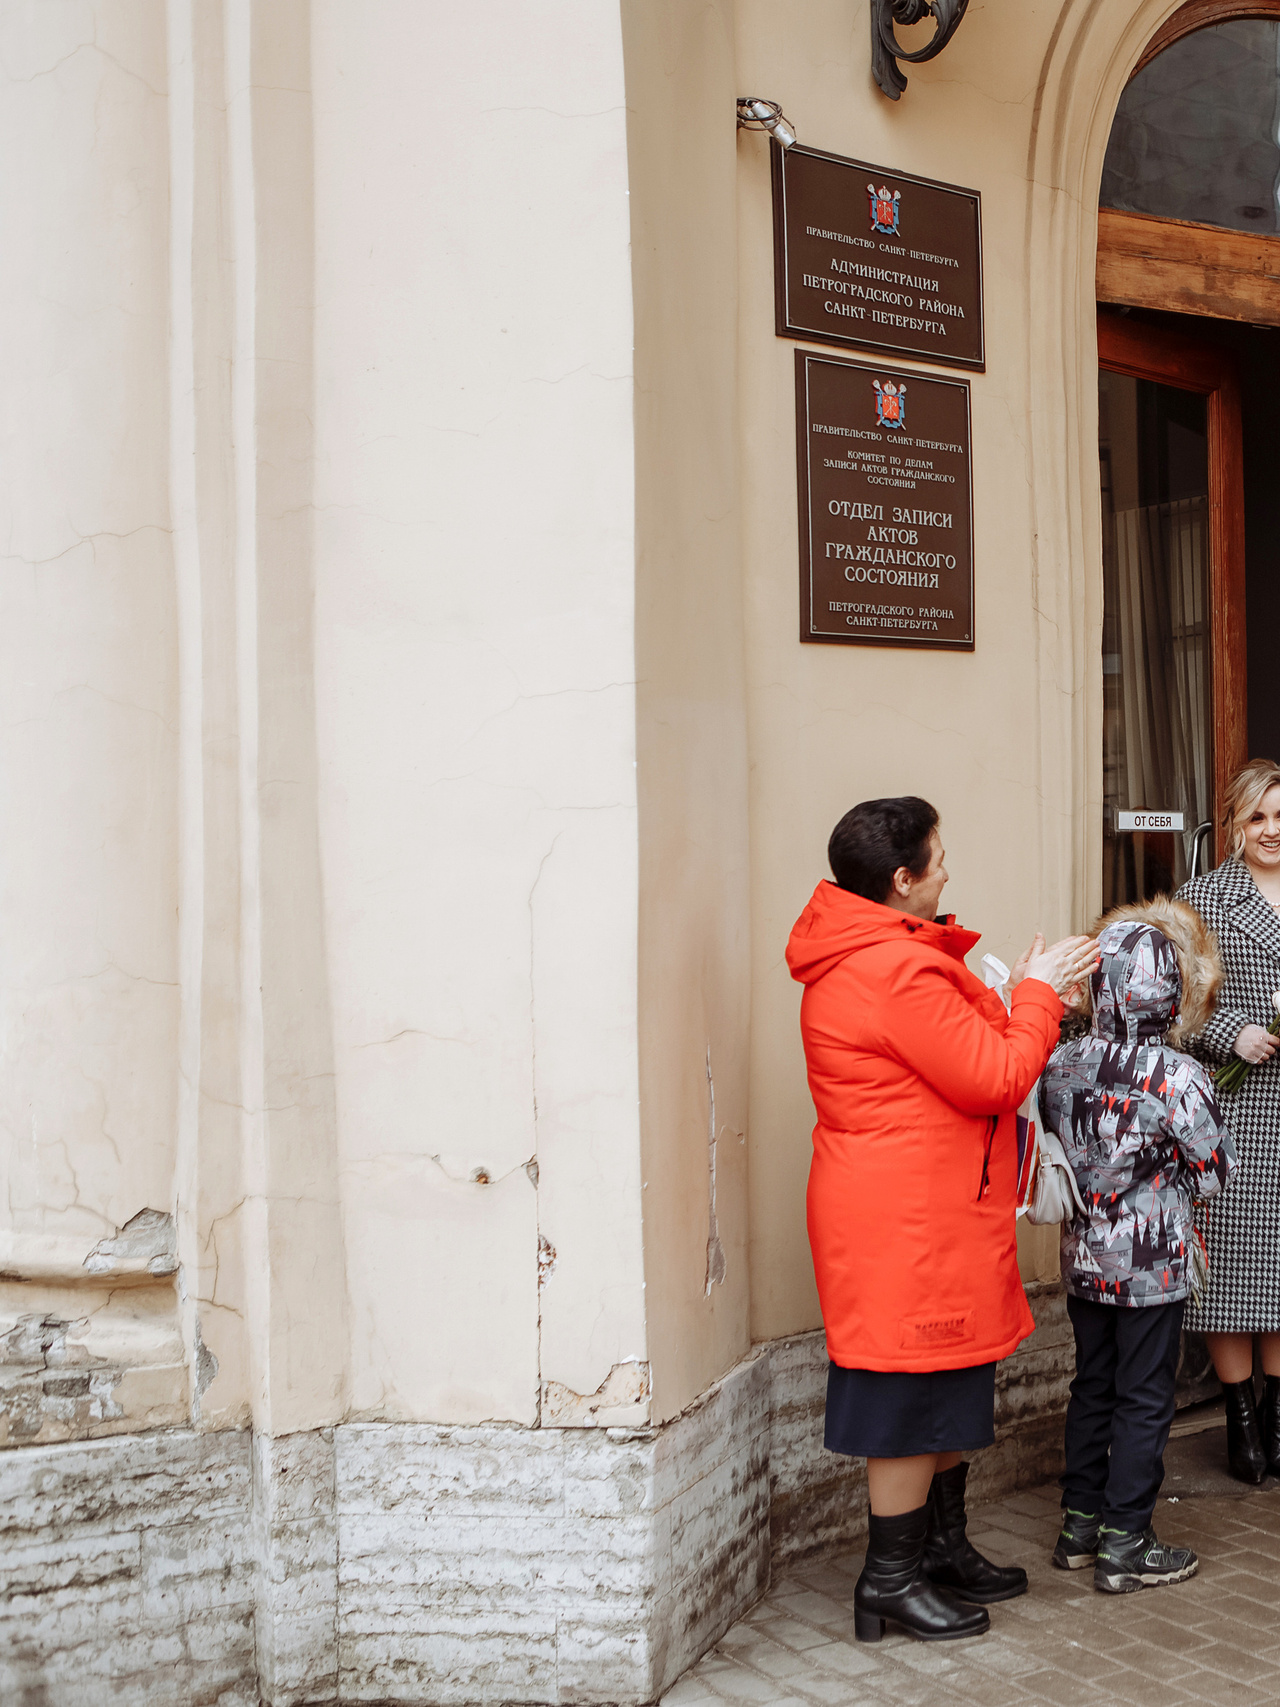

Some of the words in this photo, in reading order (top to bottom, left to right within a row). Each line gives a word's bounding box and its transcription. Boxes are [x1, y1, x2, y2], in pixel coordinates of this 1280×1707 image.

[806, 226, 875, 248] ПРАВИТЕЛЬСТВО
[879, 244, 959, 268] САНКТ-ПЕТЕРБУРГА
[830, 258, 939, 292] АДМИНИСТРАЦИЯ
[803, 274, 912, 308] ПЕТРОГРАДСКОГО
[919, 298, 965, 318] РАЙОНА
[824, 301, 946, 335] САНКТ-ПЕТЕРБУРГА
[812, 424, 882, 441] ПРАВИТЕЛЬСТВО
[886, 434, 963, 453] САНКТ-ПЕТЕРБУРГА
[824, 458, 858, 470] ЗАПИСИ
[861, 464, 888, 474] АКТОВ
[891, 468, 956, 484] ГРАЖДАНСКОГО
[848, 450, 886, 463] КОМИТЕТ
[890, 456, 900, 465] ПО
[905, 458, 933, 469] ДЕЛАМ
[867, 476, 916, 489] СОСТОЯНИЯ
[828, 500, 884, 521] ОТДЕЛ
[892, 508, 952, 528] ЗАПИСИ
[867, 526, 918, 545] АКТОВ
[825, 542, 956, 570] ГРАЖДАНСКОГО
[844, 566, 939, 588] СОСТОЯНИЯ
[828, 602, 914, 616] ПЕТРОГРАДСКОГО
[918, 606, 954, 619] РАЙОНА
[846, 616, 938, 630] САНКТ-ПЕТЕРБУРГА
[1134, 816, 1147, 826] ОТ
[1148, 816, 1172, 827] СЕБЯ
